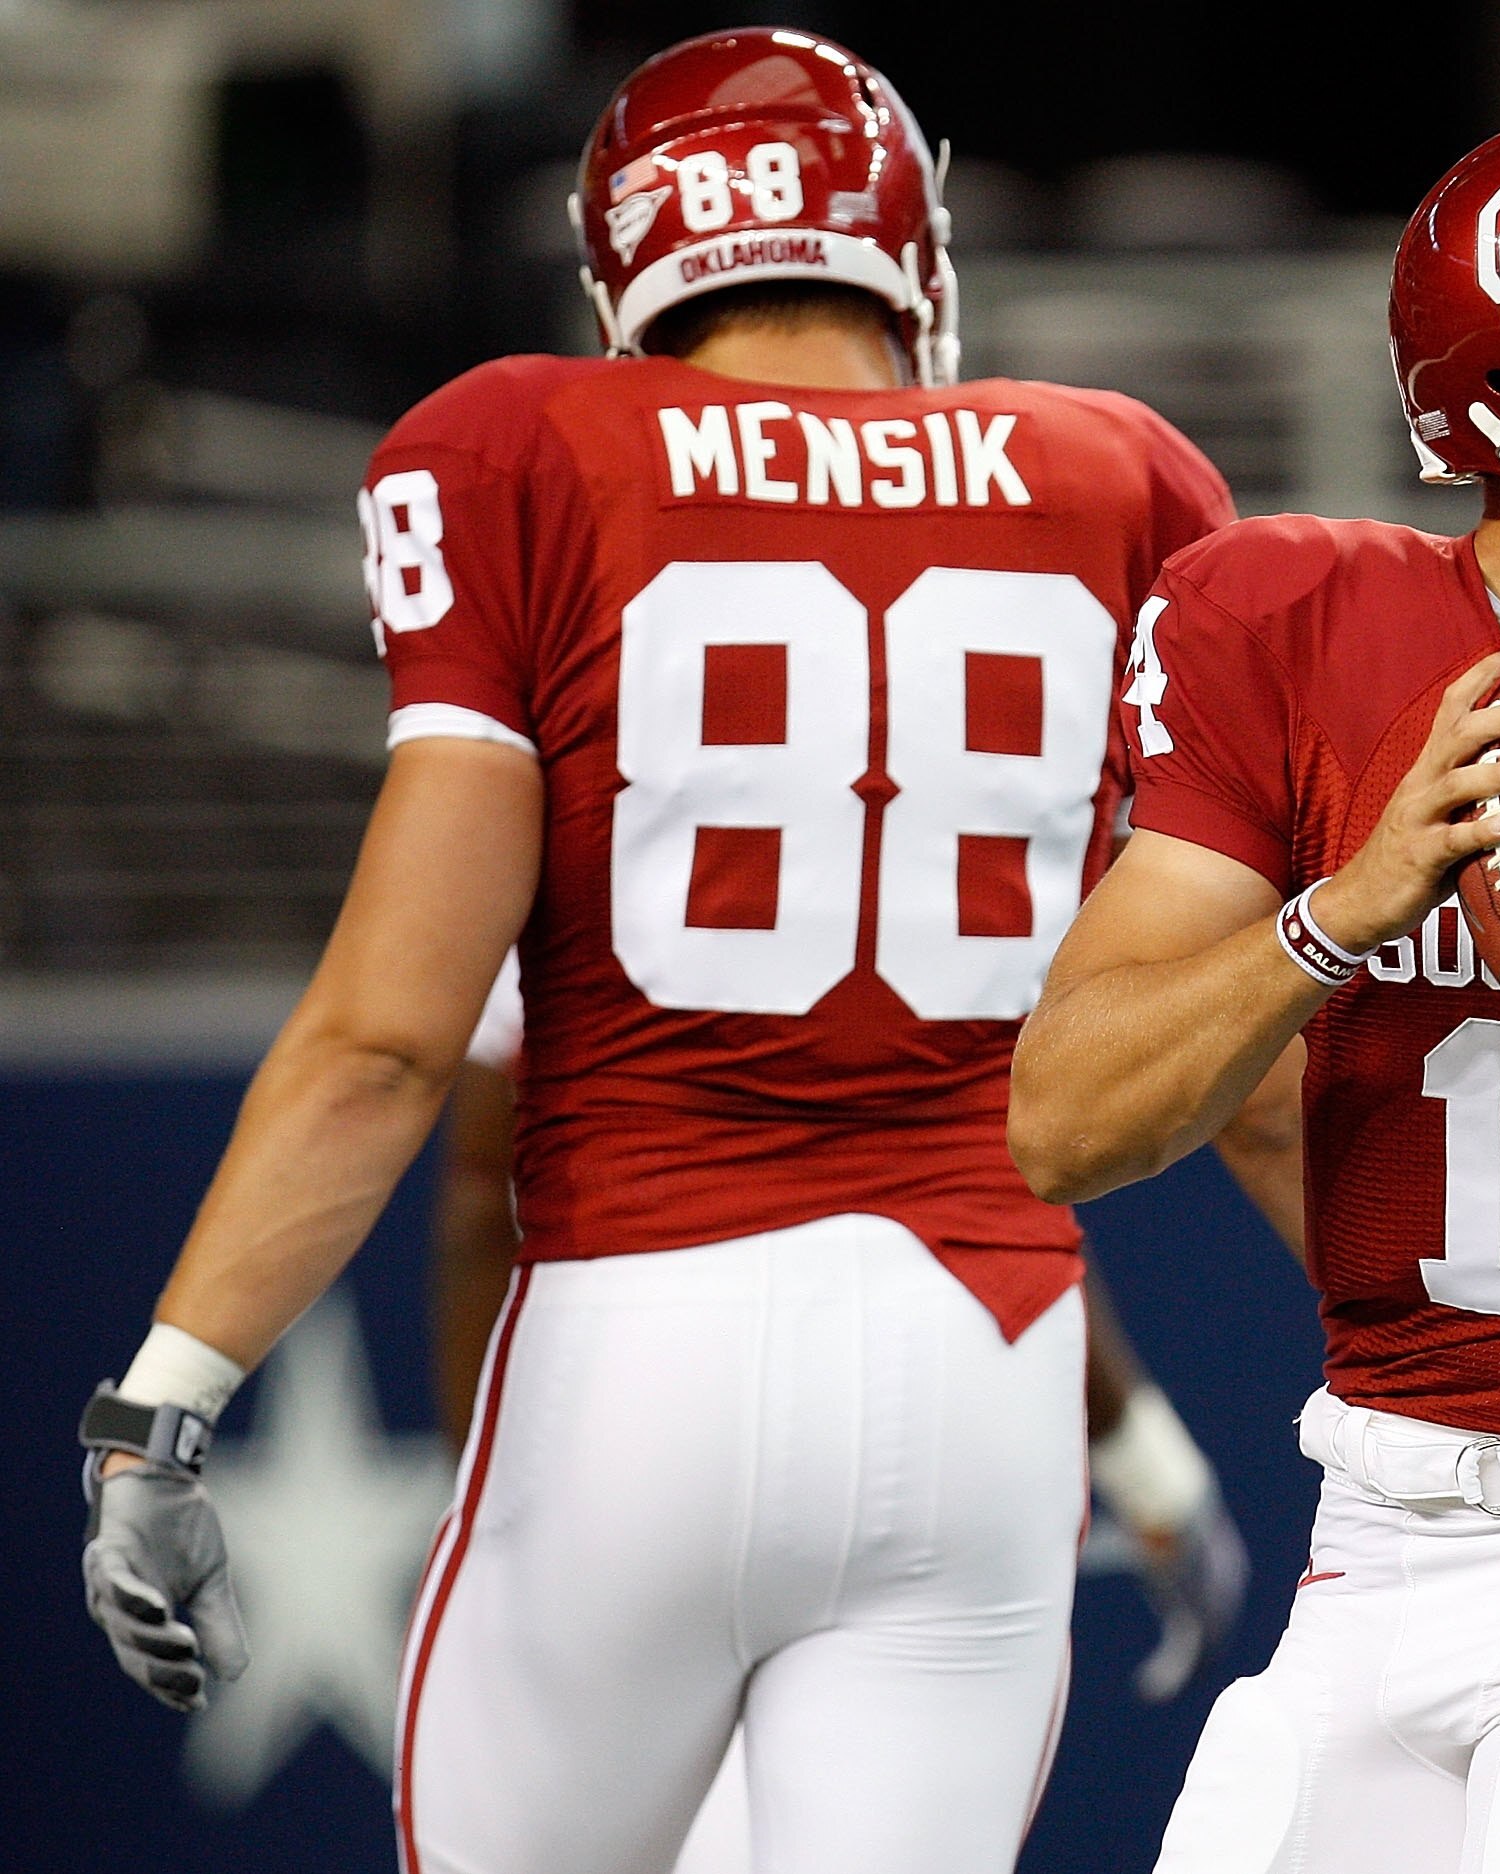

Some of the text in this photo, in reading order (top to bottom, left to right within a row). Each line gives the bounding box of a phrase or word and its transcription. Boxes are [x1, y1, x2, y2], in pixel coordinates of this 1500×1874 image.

[676, 142, 804, 233] 88
[681, 238, 828, 283] OKLAHOMA
[658, 400, 1033, 508] MENSIK
[357, 469, 454, 659] 8
[611, 560, 1119, 1021] 88
